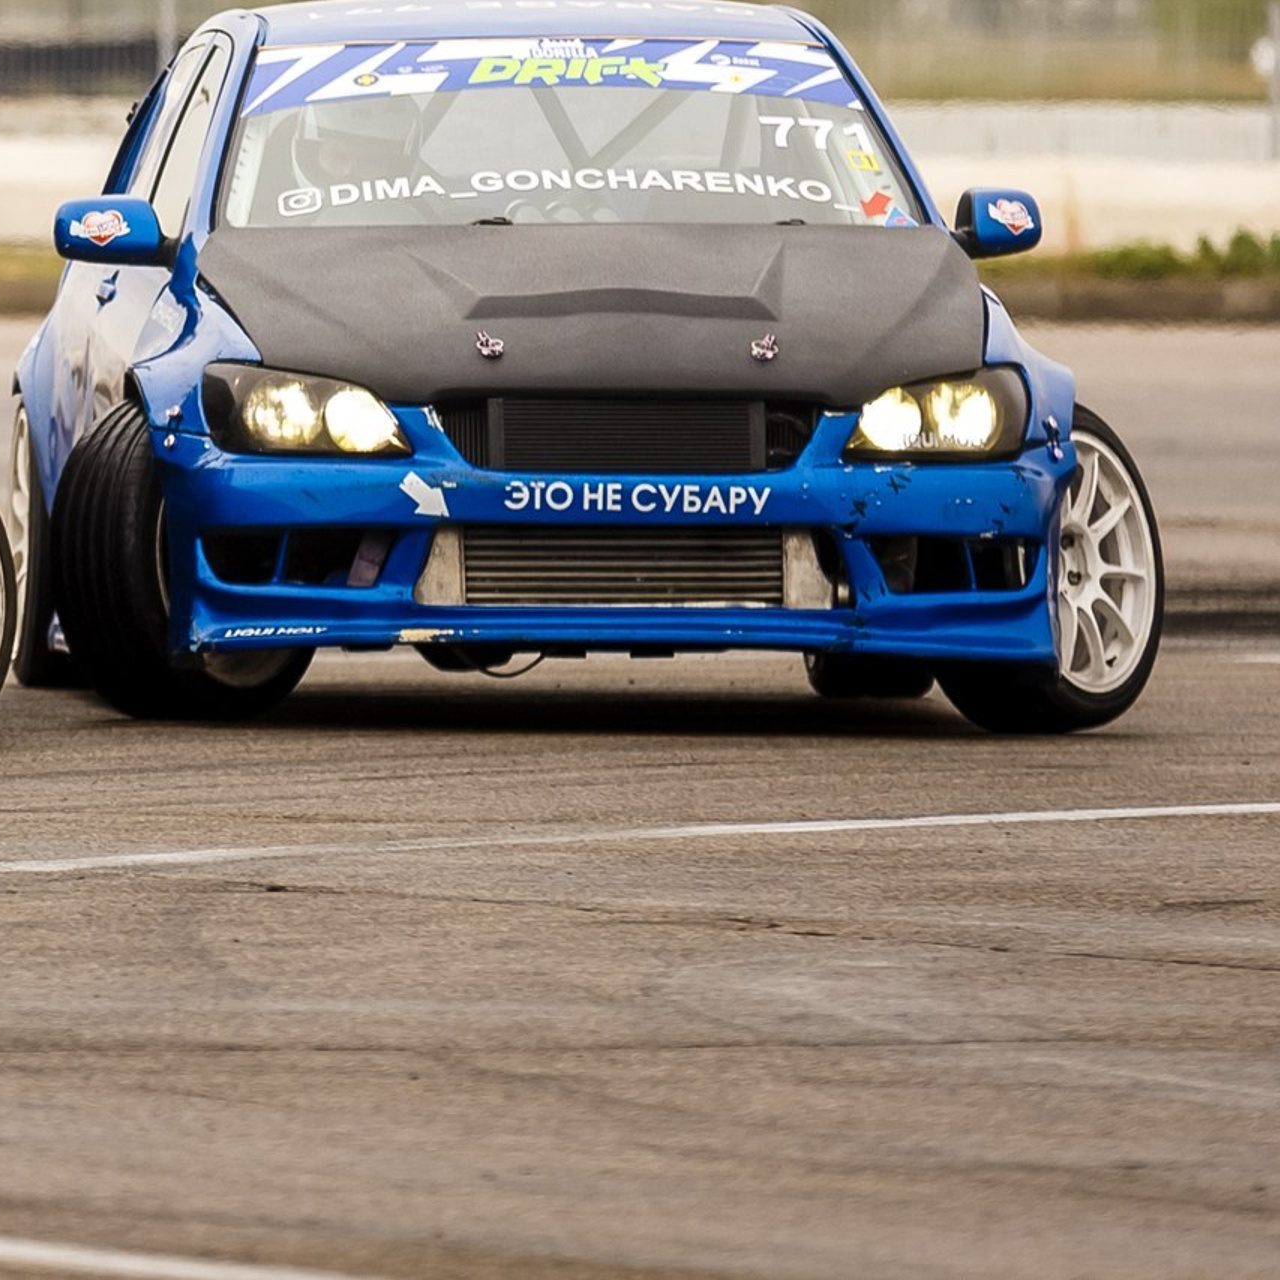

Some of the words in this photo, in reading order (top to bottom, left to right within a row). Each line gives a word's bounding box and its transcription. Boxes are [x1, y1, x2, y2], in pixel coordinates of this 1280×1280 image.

[758, 116, 874, 154] 771
[503, 481, 574, 511] ЭТО
[582, 482, 622, 511] НЕ
[631, 483, 771, 515] СУБАРУ
